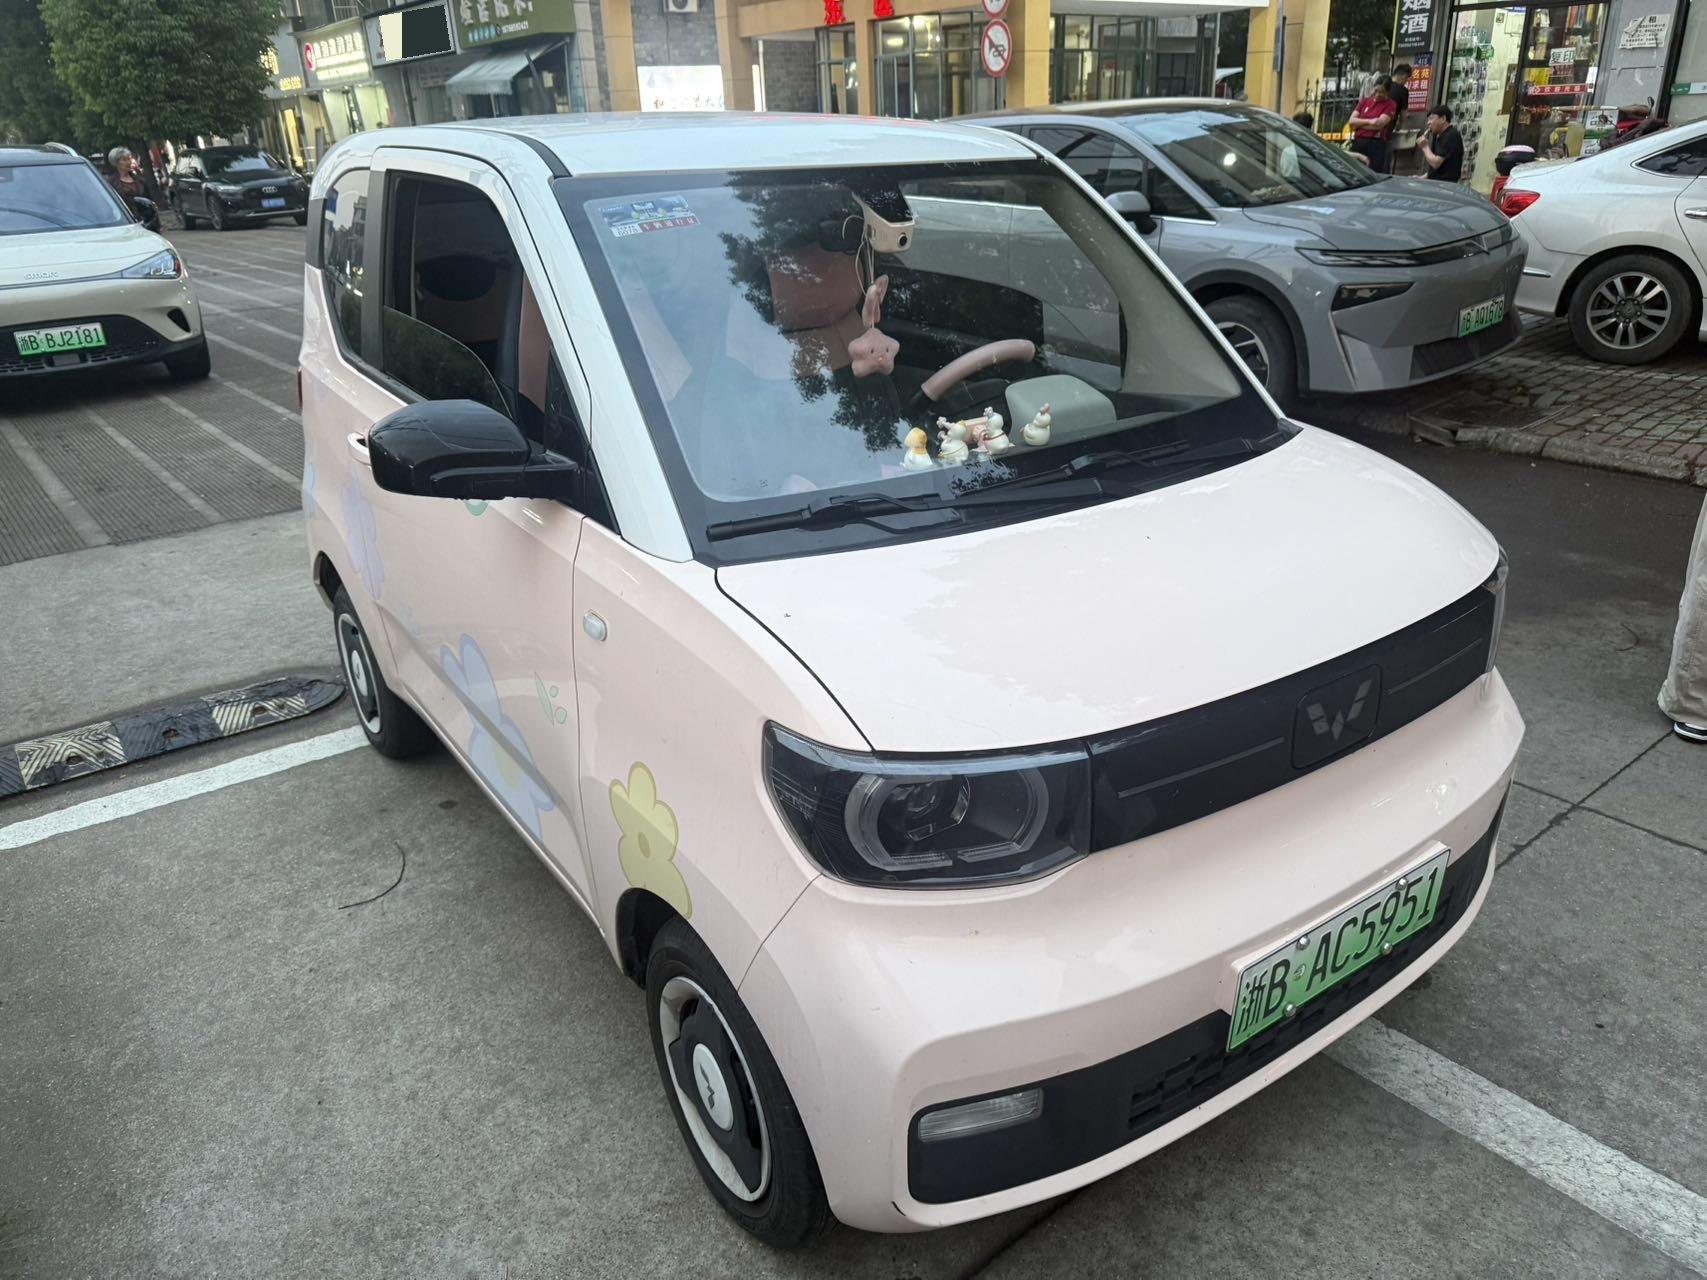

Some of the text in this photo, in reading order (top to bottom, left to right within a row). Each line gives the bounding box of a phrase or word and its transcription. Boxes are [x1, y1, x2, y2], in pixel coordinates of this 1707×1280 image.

[1550, 50, 1576, 64] 复印
[18, 327, 102, 352] 浙B BJ2181
[1236, 866, 1439, 1035] 浙B AC5951
